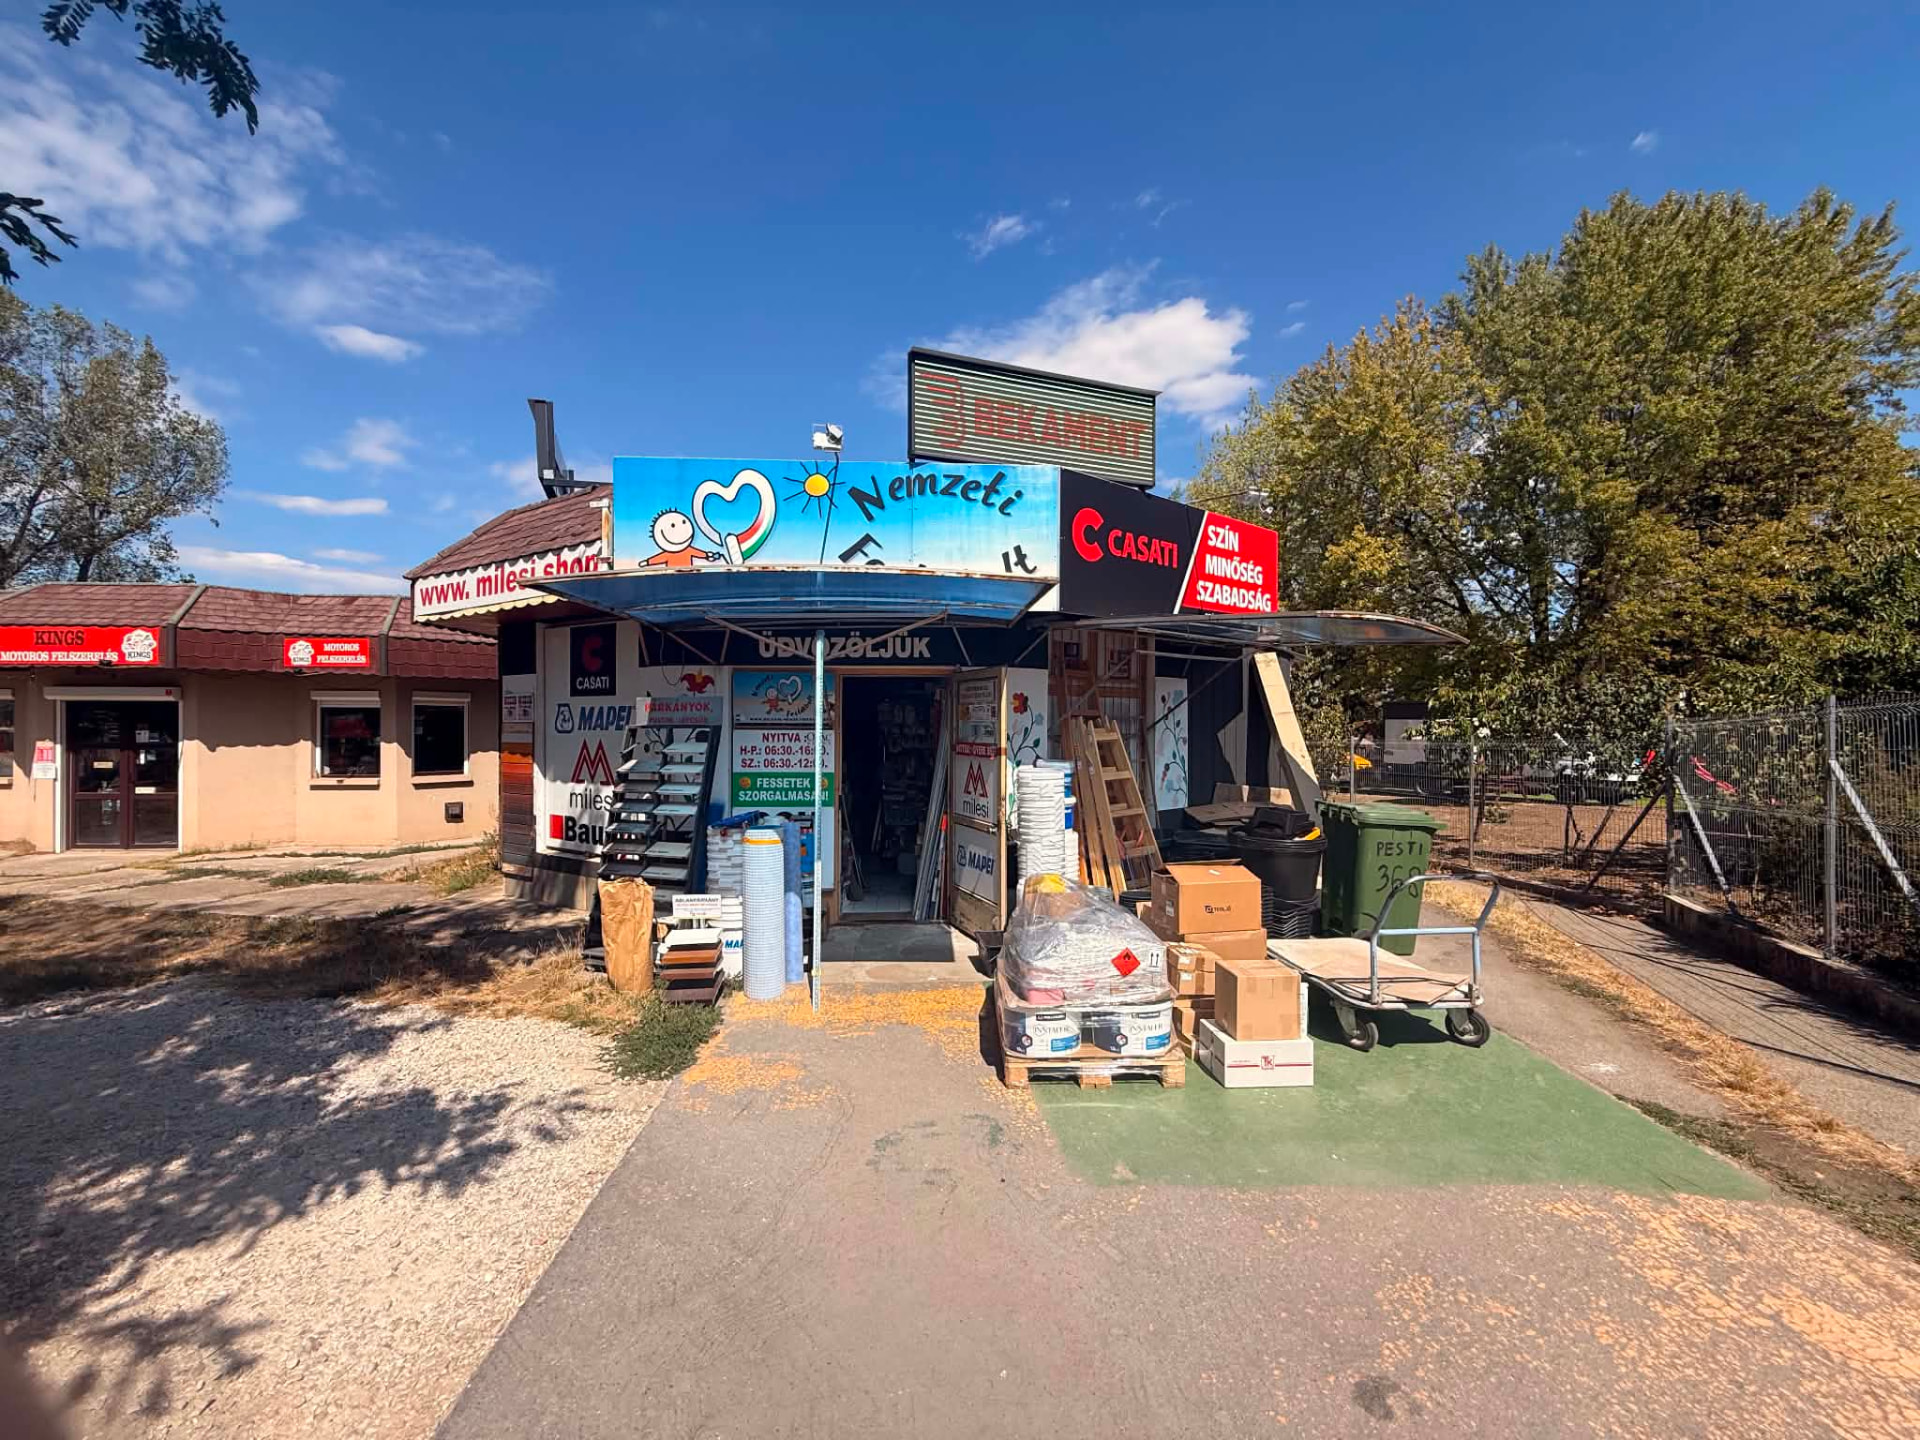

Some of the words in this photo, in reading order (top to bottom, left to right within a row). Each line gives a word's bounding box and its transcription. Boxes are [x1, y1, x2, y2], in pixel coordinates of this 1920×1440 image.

[974, 399, 1148, 458] BEKAMENT
[847, 471, 1024, 522] Nemzeti
[1108, 529, 1178, 569] CASATI
[1207, 525, 1239, 552] SZÍN
[1205, 554, 1263, 585] MINŐSÉG
[420, 580, 469, 606] www.
[1197, 580, 1271, 612] SZABADSÁG
[34, 630, 84, 645] KINGS
[323, 643, 359, 651] MOTOROS
[1, 651, 48, 661] MOTOROS
[51, 648, 118, 661] FELSZERELÉS
[576, 677, 609, 690] CASATI
[577, 705, 632, 731] MAPEI
[762, 732, 801, 743] NYITVA
[764, 745, 830, 756] 06:30.-16:0.
[756, 777, 811, 788] FESSETEK
[569, 787, 613, 811] miles
[962, 800, 990, 818] milesi
[1376, 841, 1423, 857] PESTI
[967, 851, 995, 875] MAPEI
